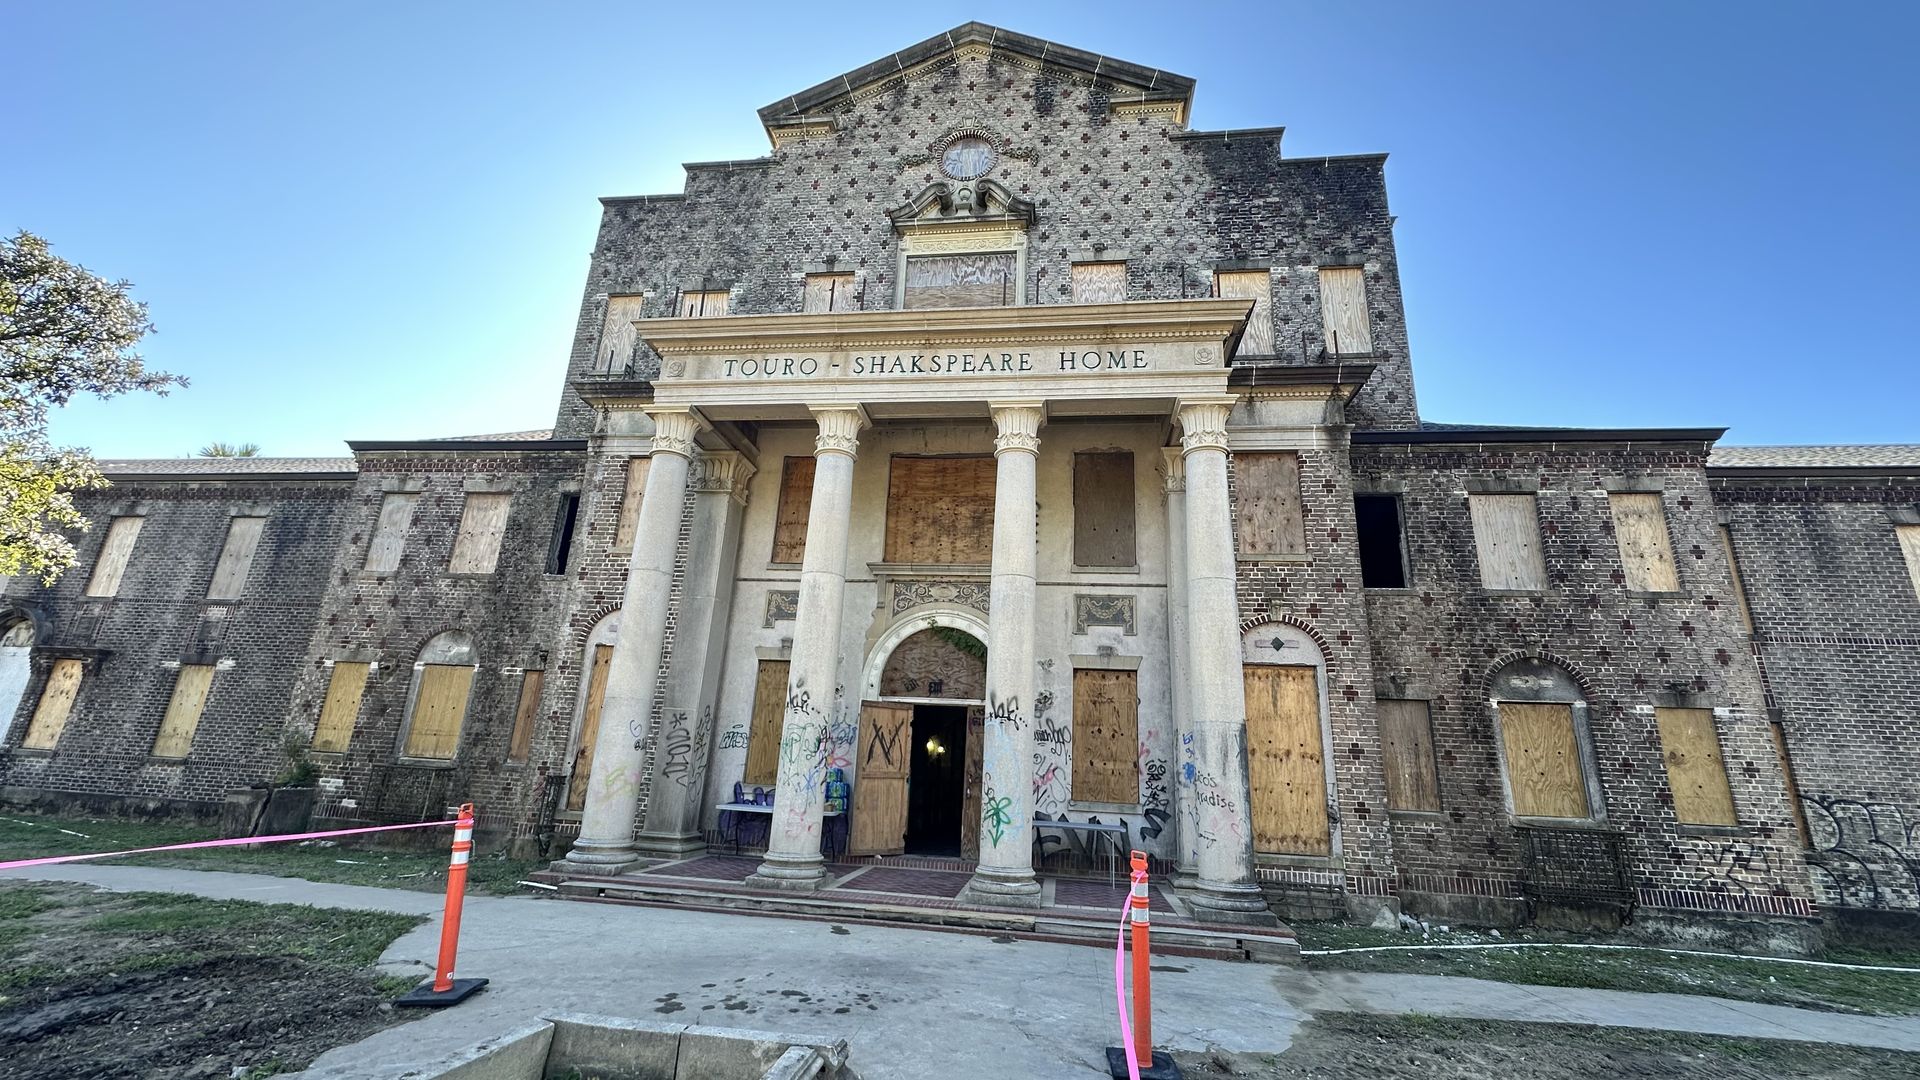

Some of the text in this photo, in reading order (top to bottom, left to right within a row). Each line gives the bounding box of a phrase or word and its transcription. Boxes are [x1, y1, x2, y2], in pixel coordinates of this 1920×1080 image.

[724, 357, 818, 377] TOURO
[853, 352, 1034, 375] SHAKSPEARE
[1059, 350, 1149, 371] HOME
